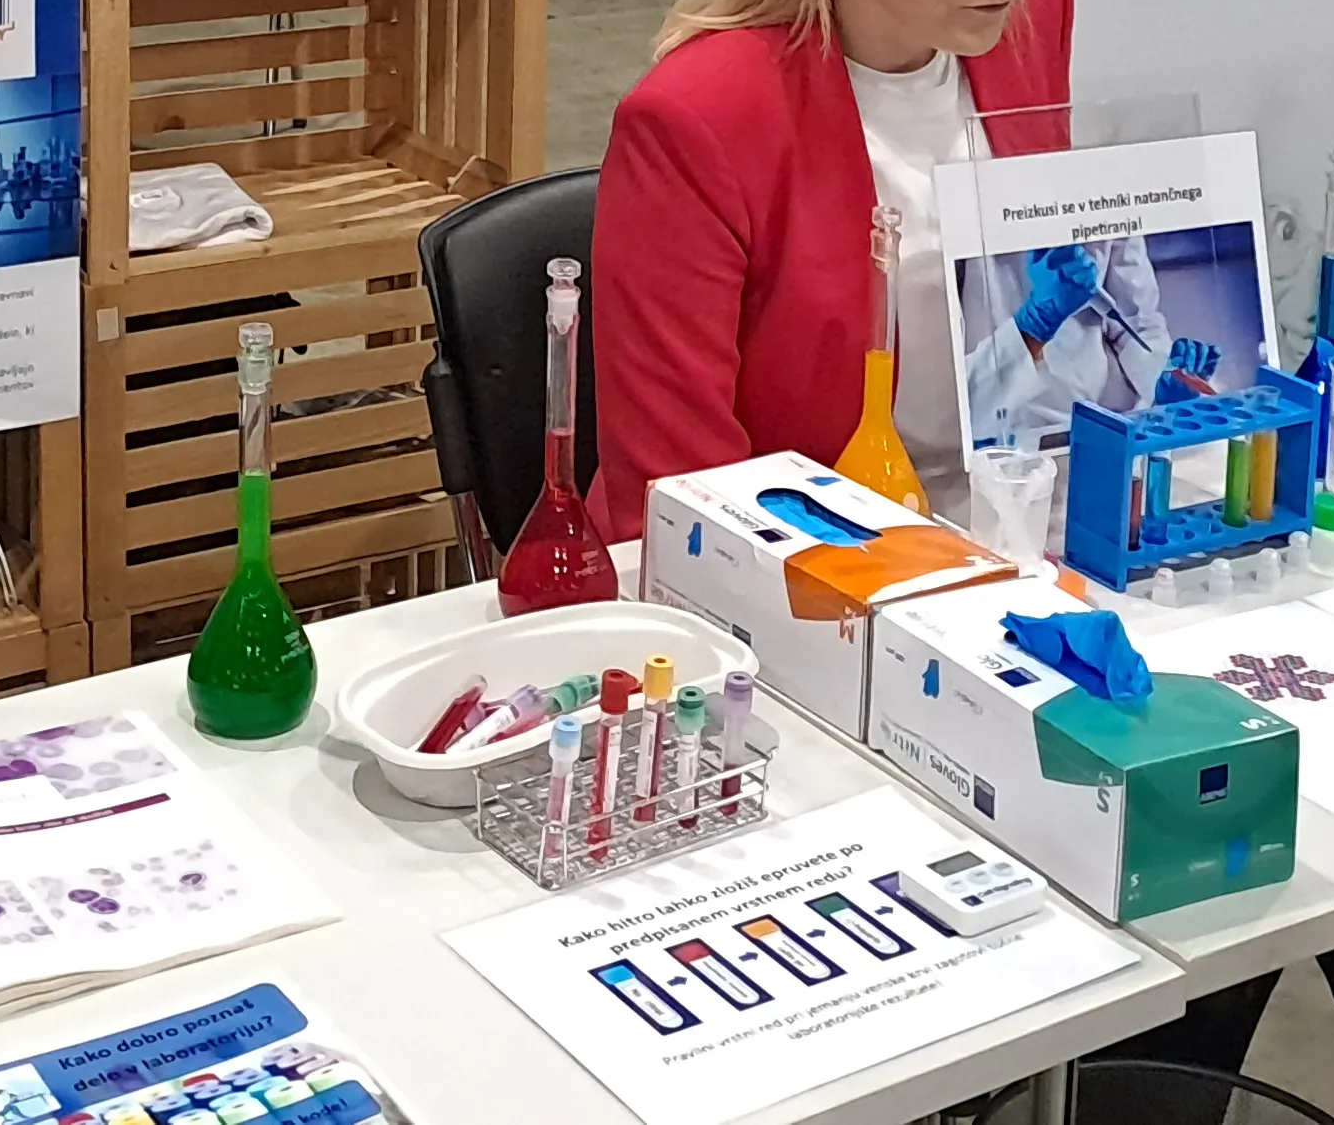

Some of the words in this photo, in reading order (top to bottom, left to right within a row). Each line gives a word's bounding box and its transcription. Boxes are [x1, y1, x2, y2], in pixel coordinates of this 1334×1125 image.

[1003, 201, 1059, 222] Preizkusi
[1062, 201, 1076, 215] se
[1079, 202, 1088, 213] v
[1089, 191, 1131, 211] tehniki
[1134, 185, 1203, 208] natančnega
[929, 753, 971, 798] Gloves
[558, 926, 607, 948] Kako
[607, 911, 655, 931] hitro
[656, 894, 708, 922] lahko
[711, 875, 759, 899] zložiš
[761, 852, 838, 883] epruvete
[840, 842, 865, 859] po
[609, 907, 729, 956] predpisanem
[730, 883, 806, 914] vrstnem
[806, 865, 854, 889] redu?
[58, 1045, 112, 1071] Kako
[117, 1024, 179, 1053] dobro
[73, 1068, 123, 1094] delo
[141, 1015, 276, 1071] laboratoriju?
